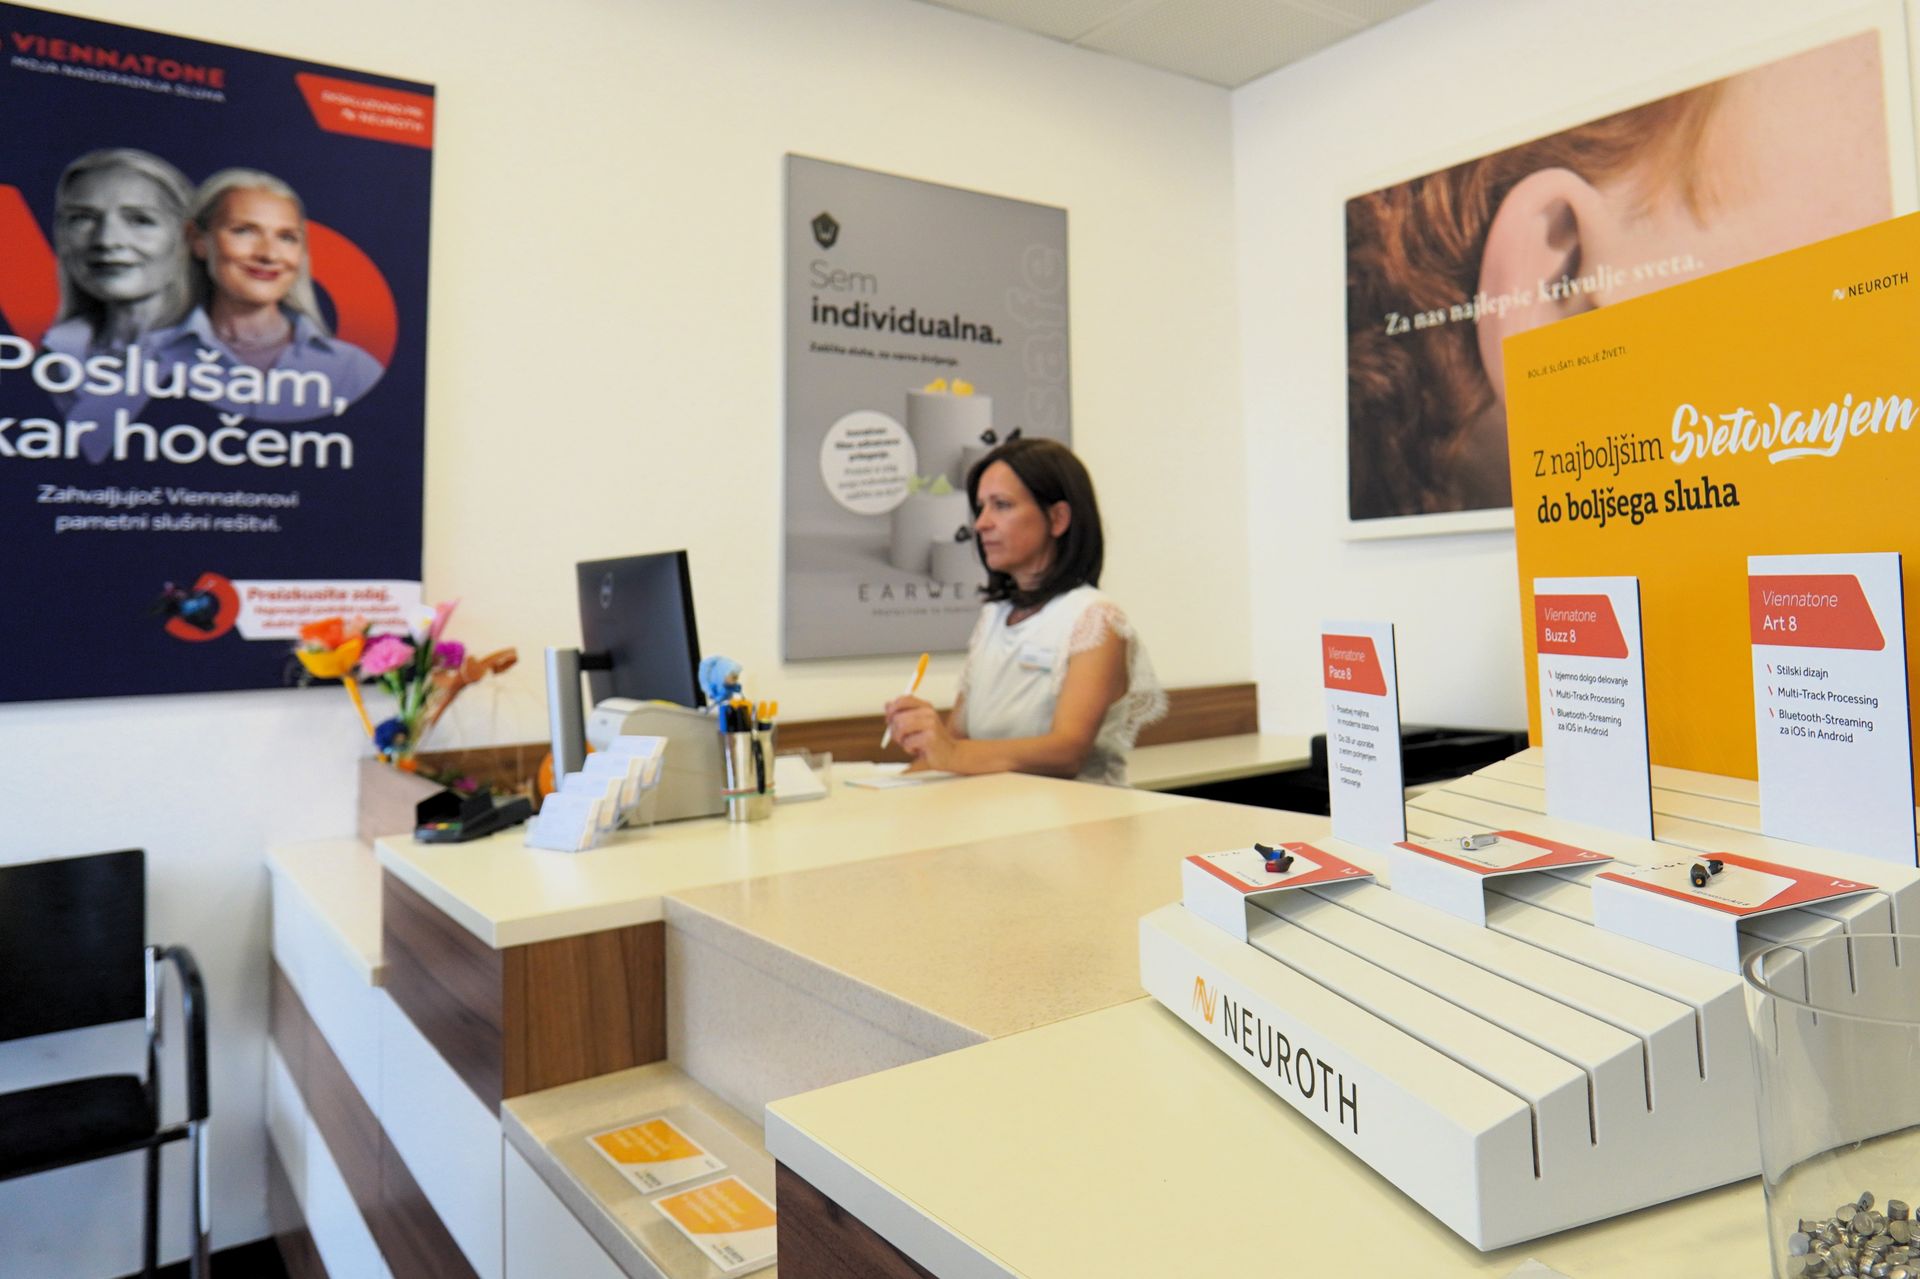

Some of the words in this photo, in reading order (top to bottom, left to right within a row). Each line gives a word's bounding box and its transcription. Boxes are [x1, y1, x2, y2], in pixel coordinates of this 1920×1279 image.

[11, 31, 225, 88] VIENNATONE
[809, 258, 878, 294] Sem
[1848, 272, 1909, 297] NEUROTH
[1385, 313, 1411, 336] Za
[1414, 307, 1446, 330] nas
[1537, 264, 1625, 301] krivulje
[812, 296, 1002, 346] individualna.
[1577, 352, 1600, 367] BOLJE
[113, 408, 354, 470] hočem
[1534, 451, 1546, 477] Z
[1551, 432, 1664, 481] najboljšim
[1670, 392, 1919, 465] Svetovanjem
[1537, 495, 1562, 523] do
[1566, 486, 1658, 528] boljšega
[1664, 476, 1740, 512] sluha
[55, 513, 149, 534] pametni
[151, 512, 211, 532] slušni
[1762, 590, 1838, 608] Viennatone
[1544, 607, 1597, 622] Viennatone
[1763, 615, 1786, 631] Art
[1788, 615, 1798, 632] 8
[1545, 628, 1568, 642] Buzz
[1569, 629, 1577, 643] 8
[1328, 646, 1366, 662] Viennatone
[1328, 664, 1346, 680] Pace
[1346, 667, 1352, 680] 8
[1555, 671, 1578, 682] Izjemno
[1579, 673, 1597, 685] dolgo
[1598, 675, 1629, 688] delovanje
[1776, 665, 1802, 677] Stilski
[1803, 666, 1829, 680] dizajn
[1556, 690, 1589, 701] Multi-Track
[1590, 693, 1625, 708] Processing
[1778, 687, 1826, 701] Multi-Track
[1827, 691, 1879, 708] Processing
[1557, 708, 1622, 727] Bluetooth-Streaming
[1779, 709, 1874, 732] Bluetooth-Streaming
[1566, 722, 1577, 732] iOS
[1584, 725, 1609, 737] Android
[1780, 727, 1790, 735] za
[1791, 726, 1807, 737] iOS
[1808, 728, 1816, 738] in
[1817, 729, 1854, 743] Android
[1223, 994, 1359, 1136] NEUROTH
